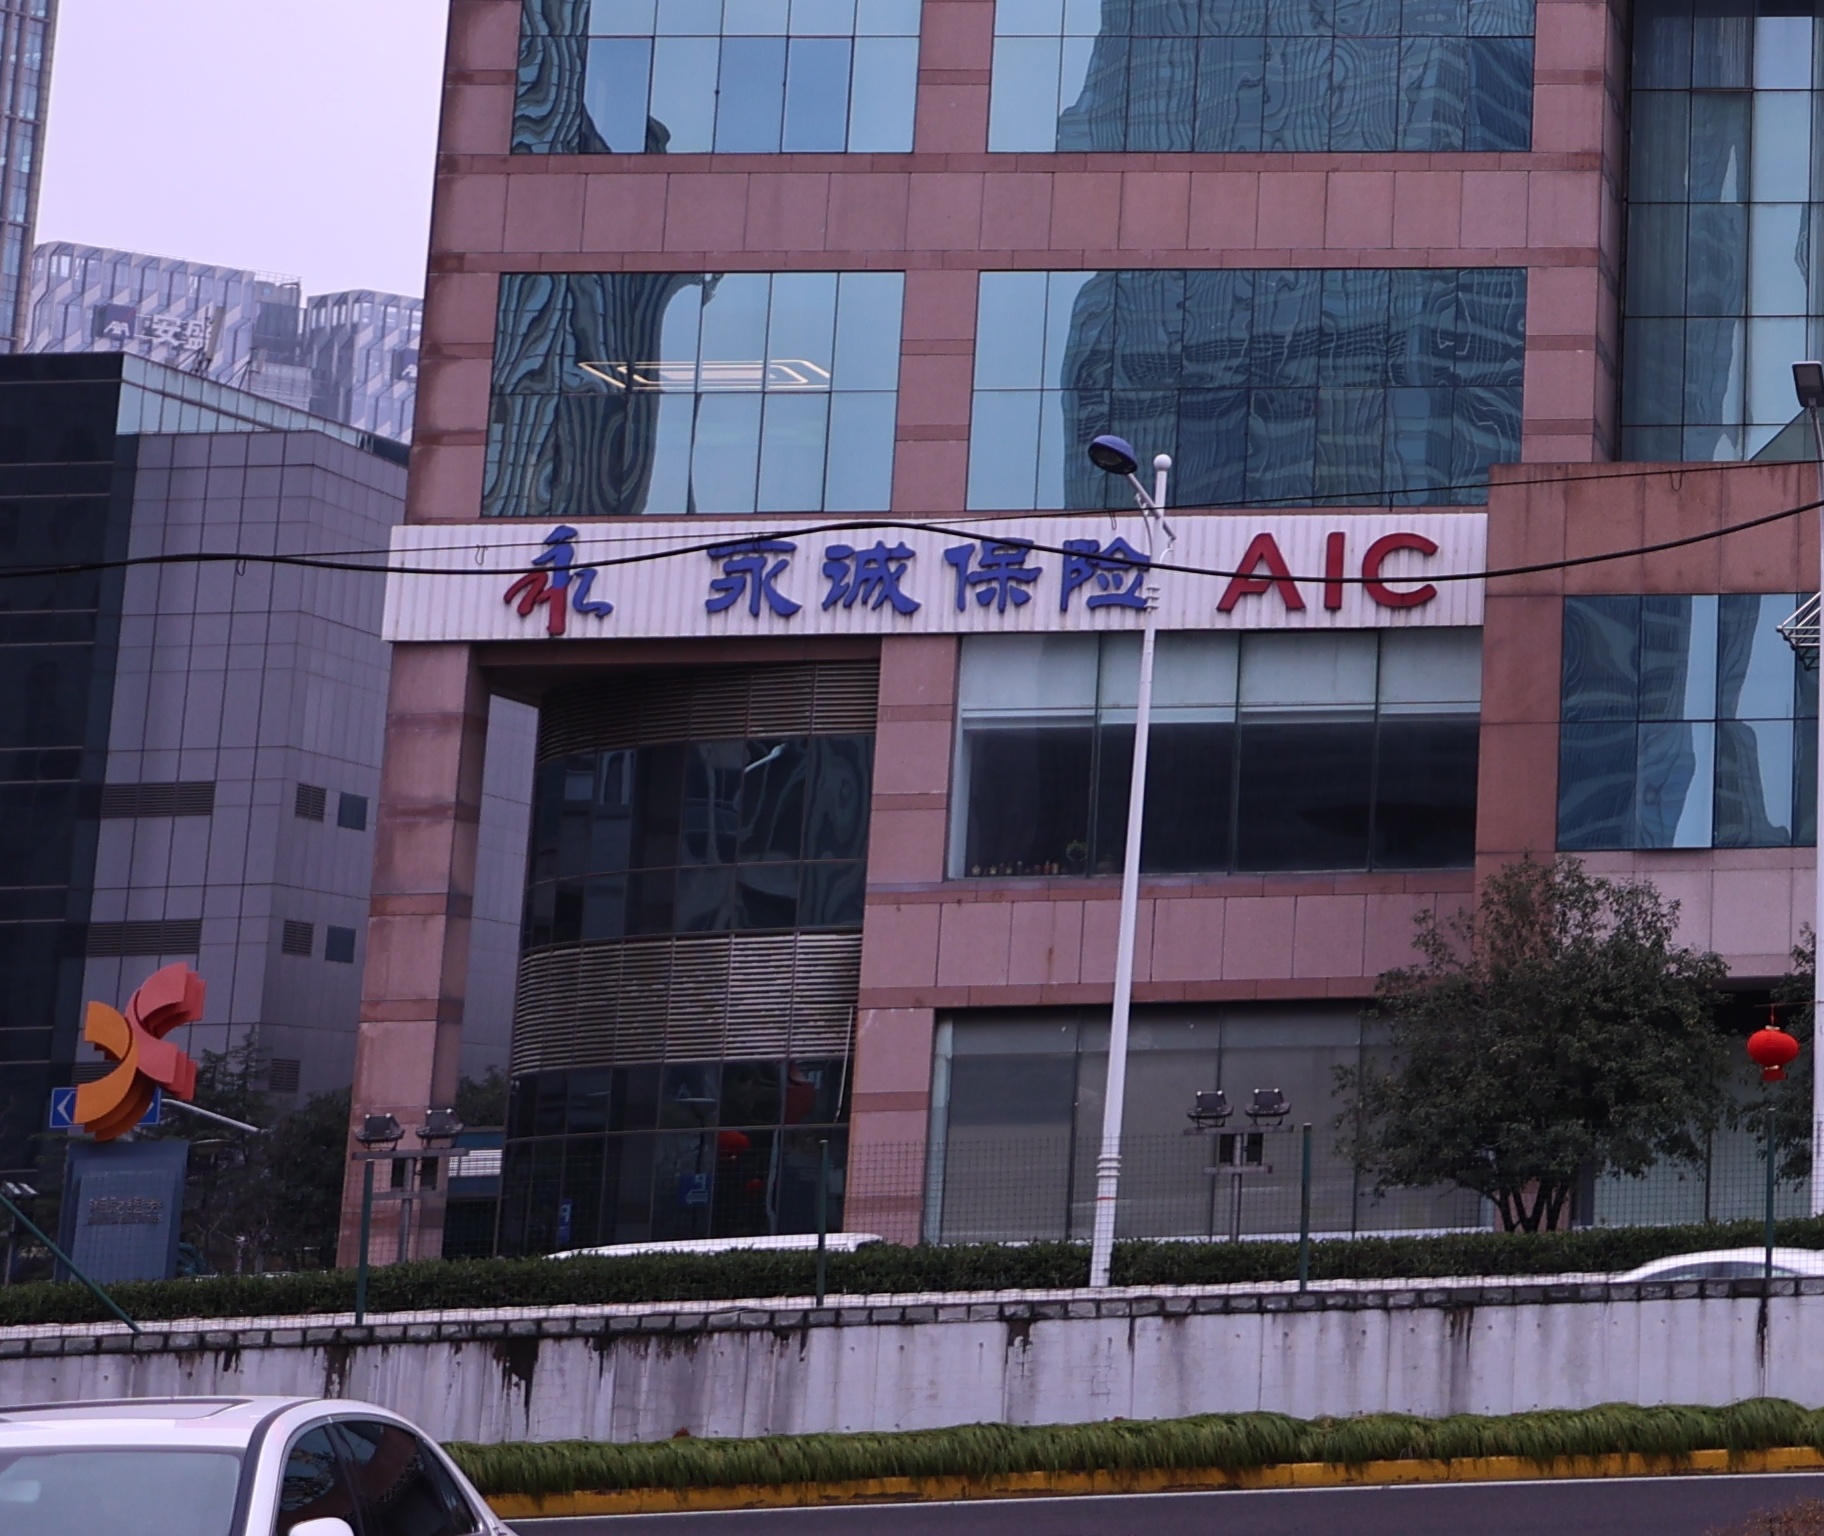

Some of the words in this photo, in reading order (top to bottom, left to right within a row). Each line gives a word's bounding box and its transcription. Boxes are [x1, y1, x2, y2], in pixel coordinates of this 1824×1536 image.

[704, 536, 1153, 617] 永诚保险
[1214, 531, 1439, 614] AIC
